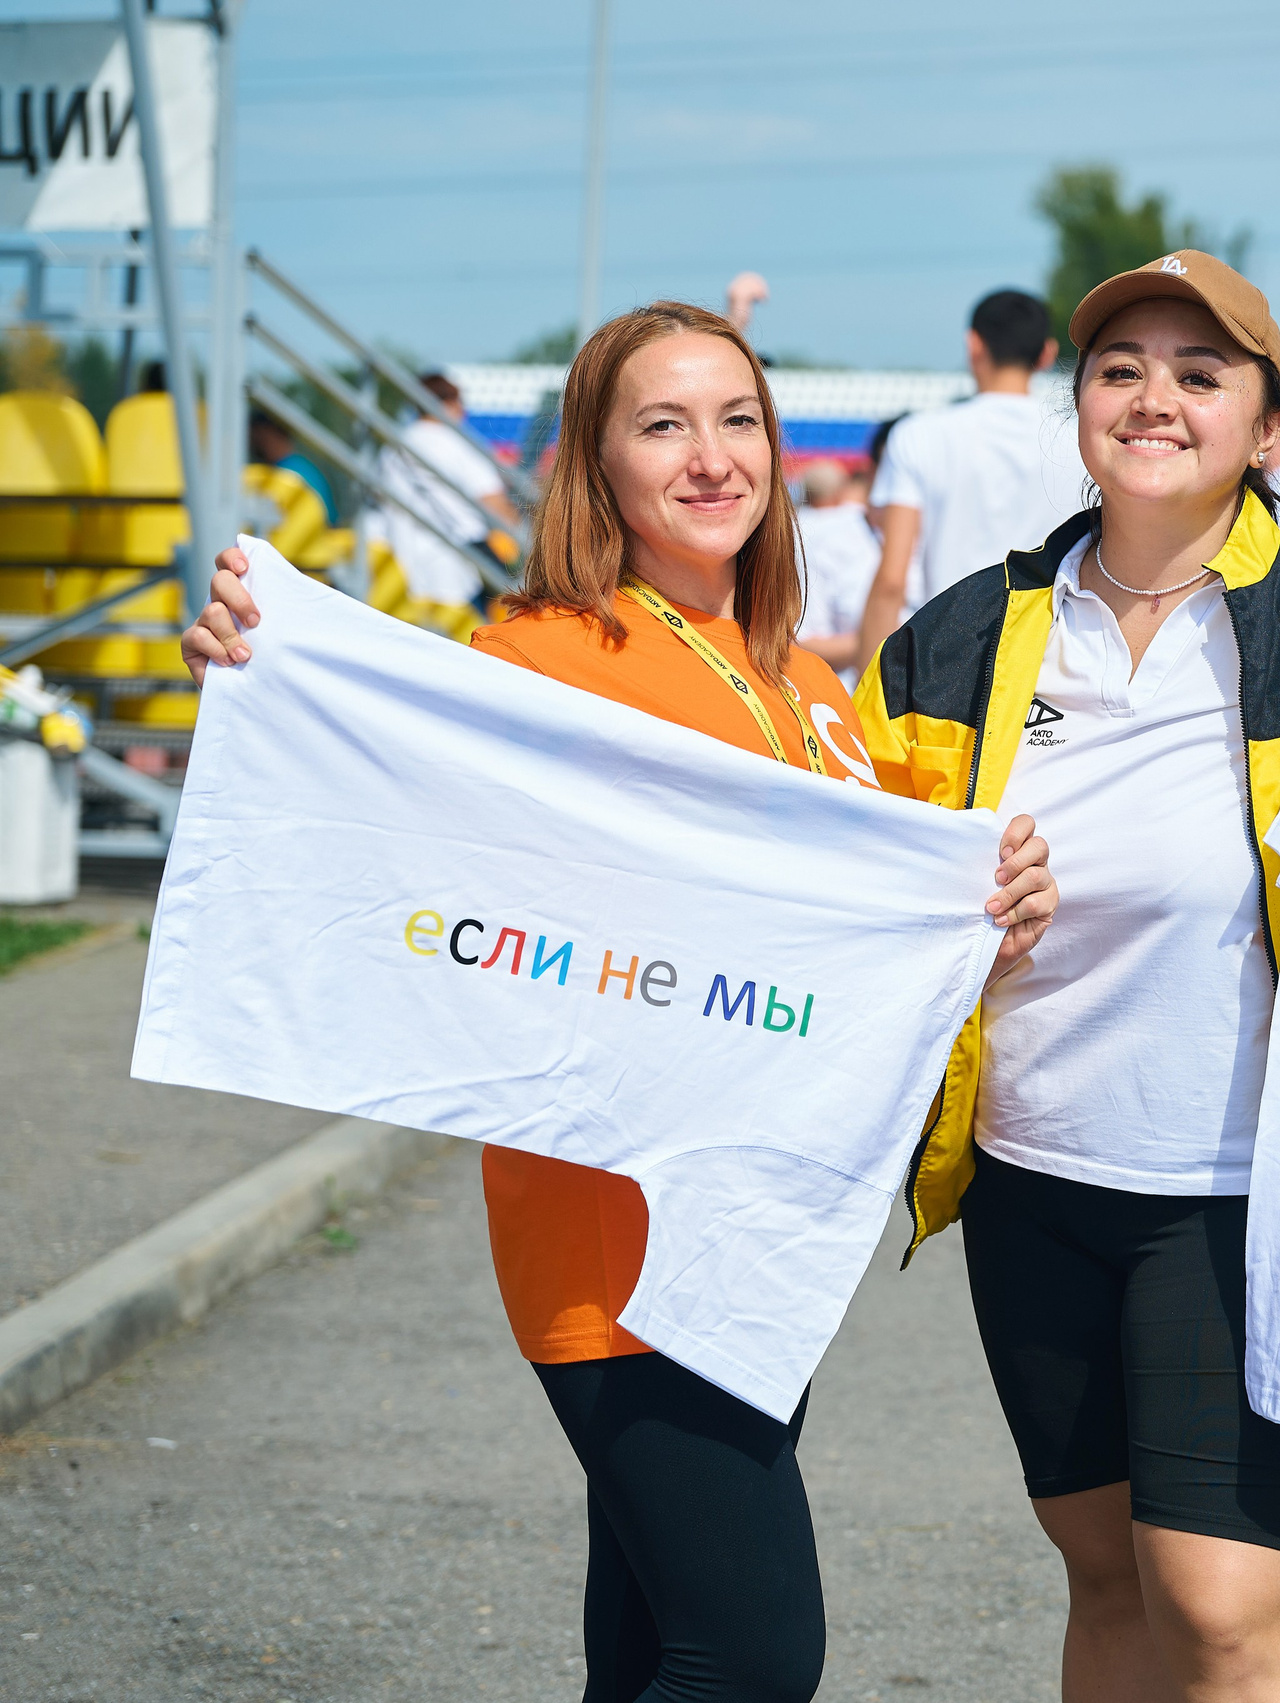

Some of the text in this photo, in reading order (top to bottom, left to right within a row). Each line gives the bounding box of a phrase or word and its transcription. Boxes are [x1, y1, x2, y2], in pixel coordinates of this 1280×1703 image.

[1161, 256, 1188, 276] LA
[1030, 729, 1053, 738] AKTO
[403, 909, 815, 1038] если не мы
